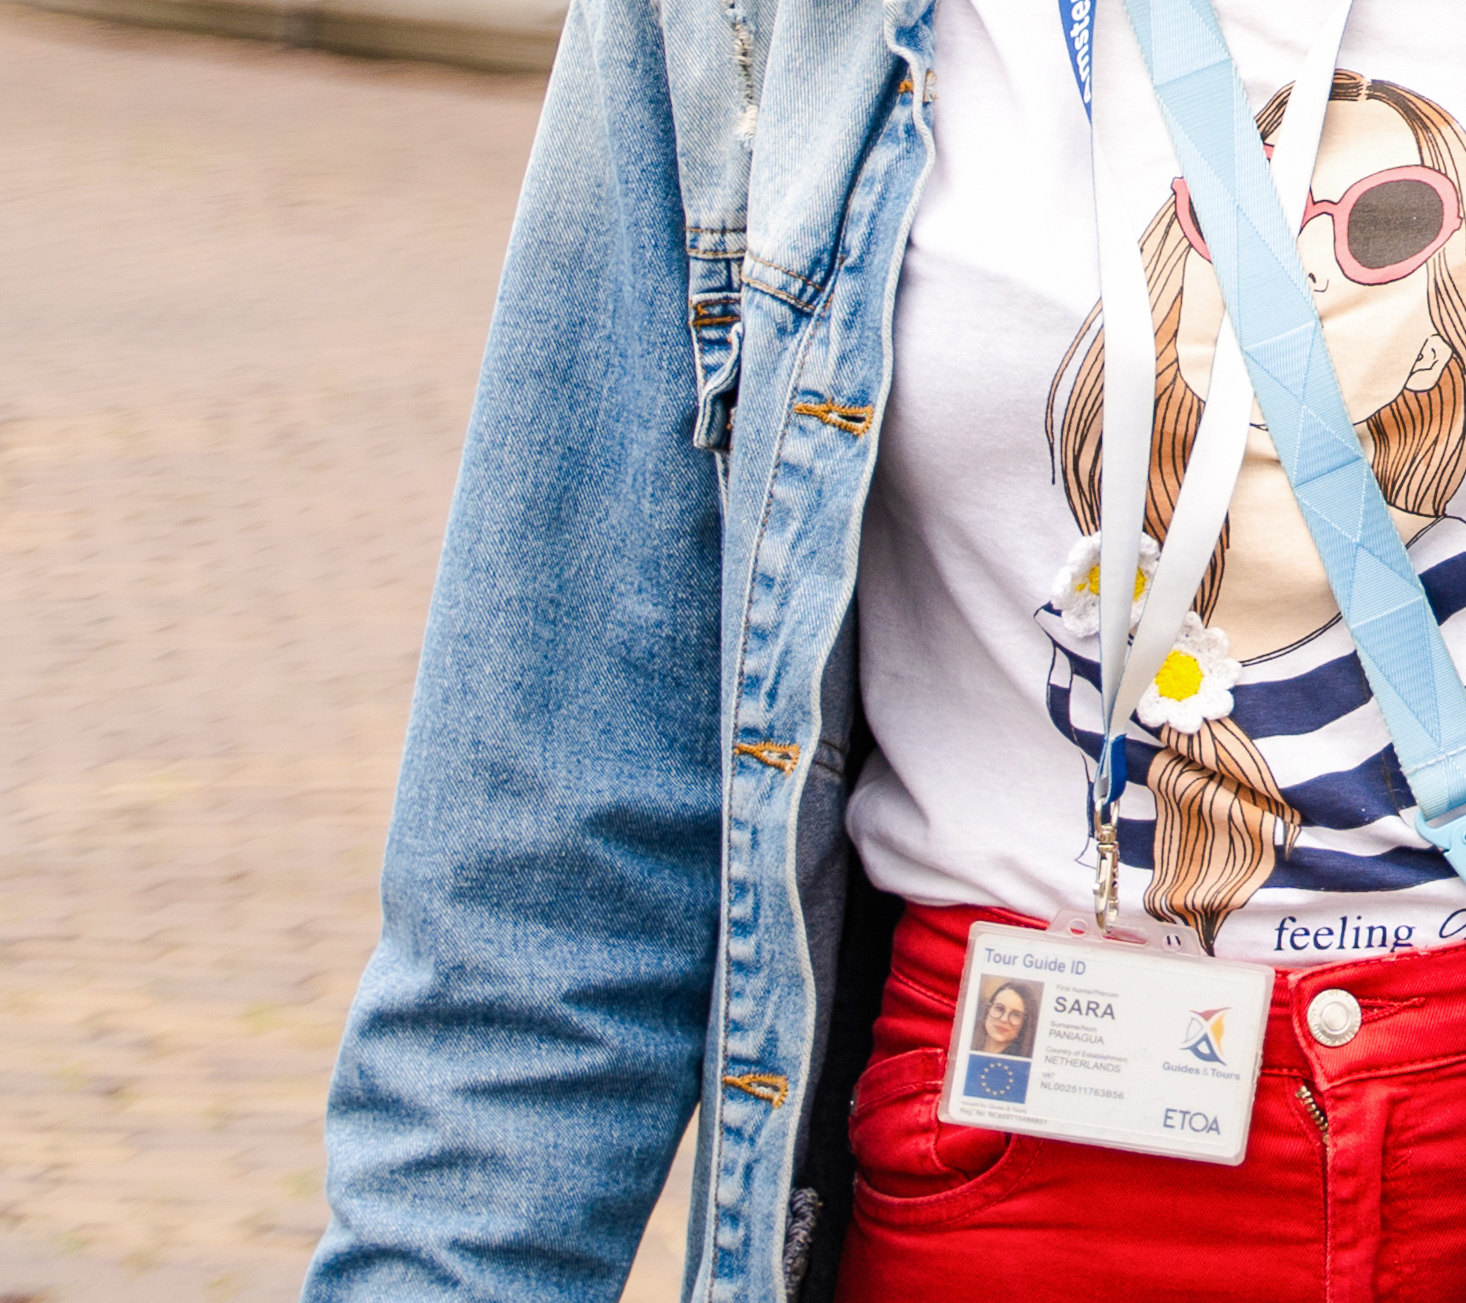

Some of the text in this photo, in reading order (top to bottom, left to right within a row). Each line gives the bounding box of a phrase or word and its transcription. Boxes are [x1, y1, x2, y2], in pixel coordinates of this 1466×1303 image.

[1273, 914, 1416, 952] feeling
[984, 947, 1087, 976] Tour Guide ID
[1053, 996, 1116, 1020] SARA
[1048, 1028, 1105, 1045] PANIAGUA
[1044, 1055, 1121, 1073] NETHERLANDS
[1162, 1061, 1201, 1076] Guides
[1210, 1067, 1241, 1081] Tours
[1162, 1107, 1222, 1136] ETOA
